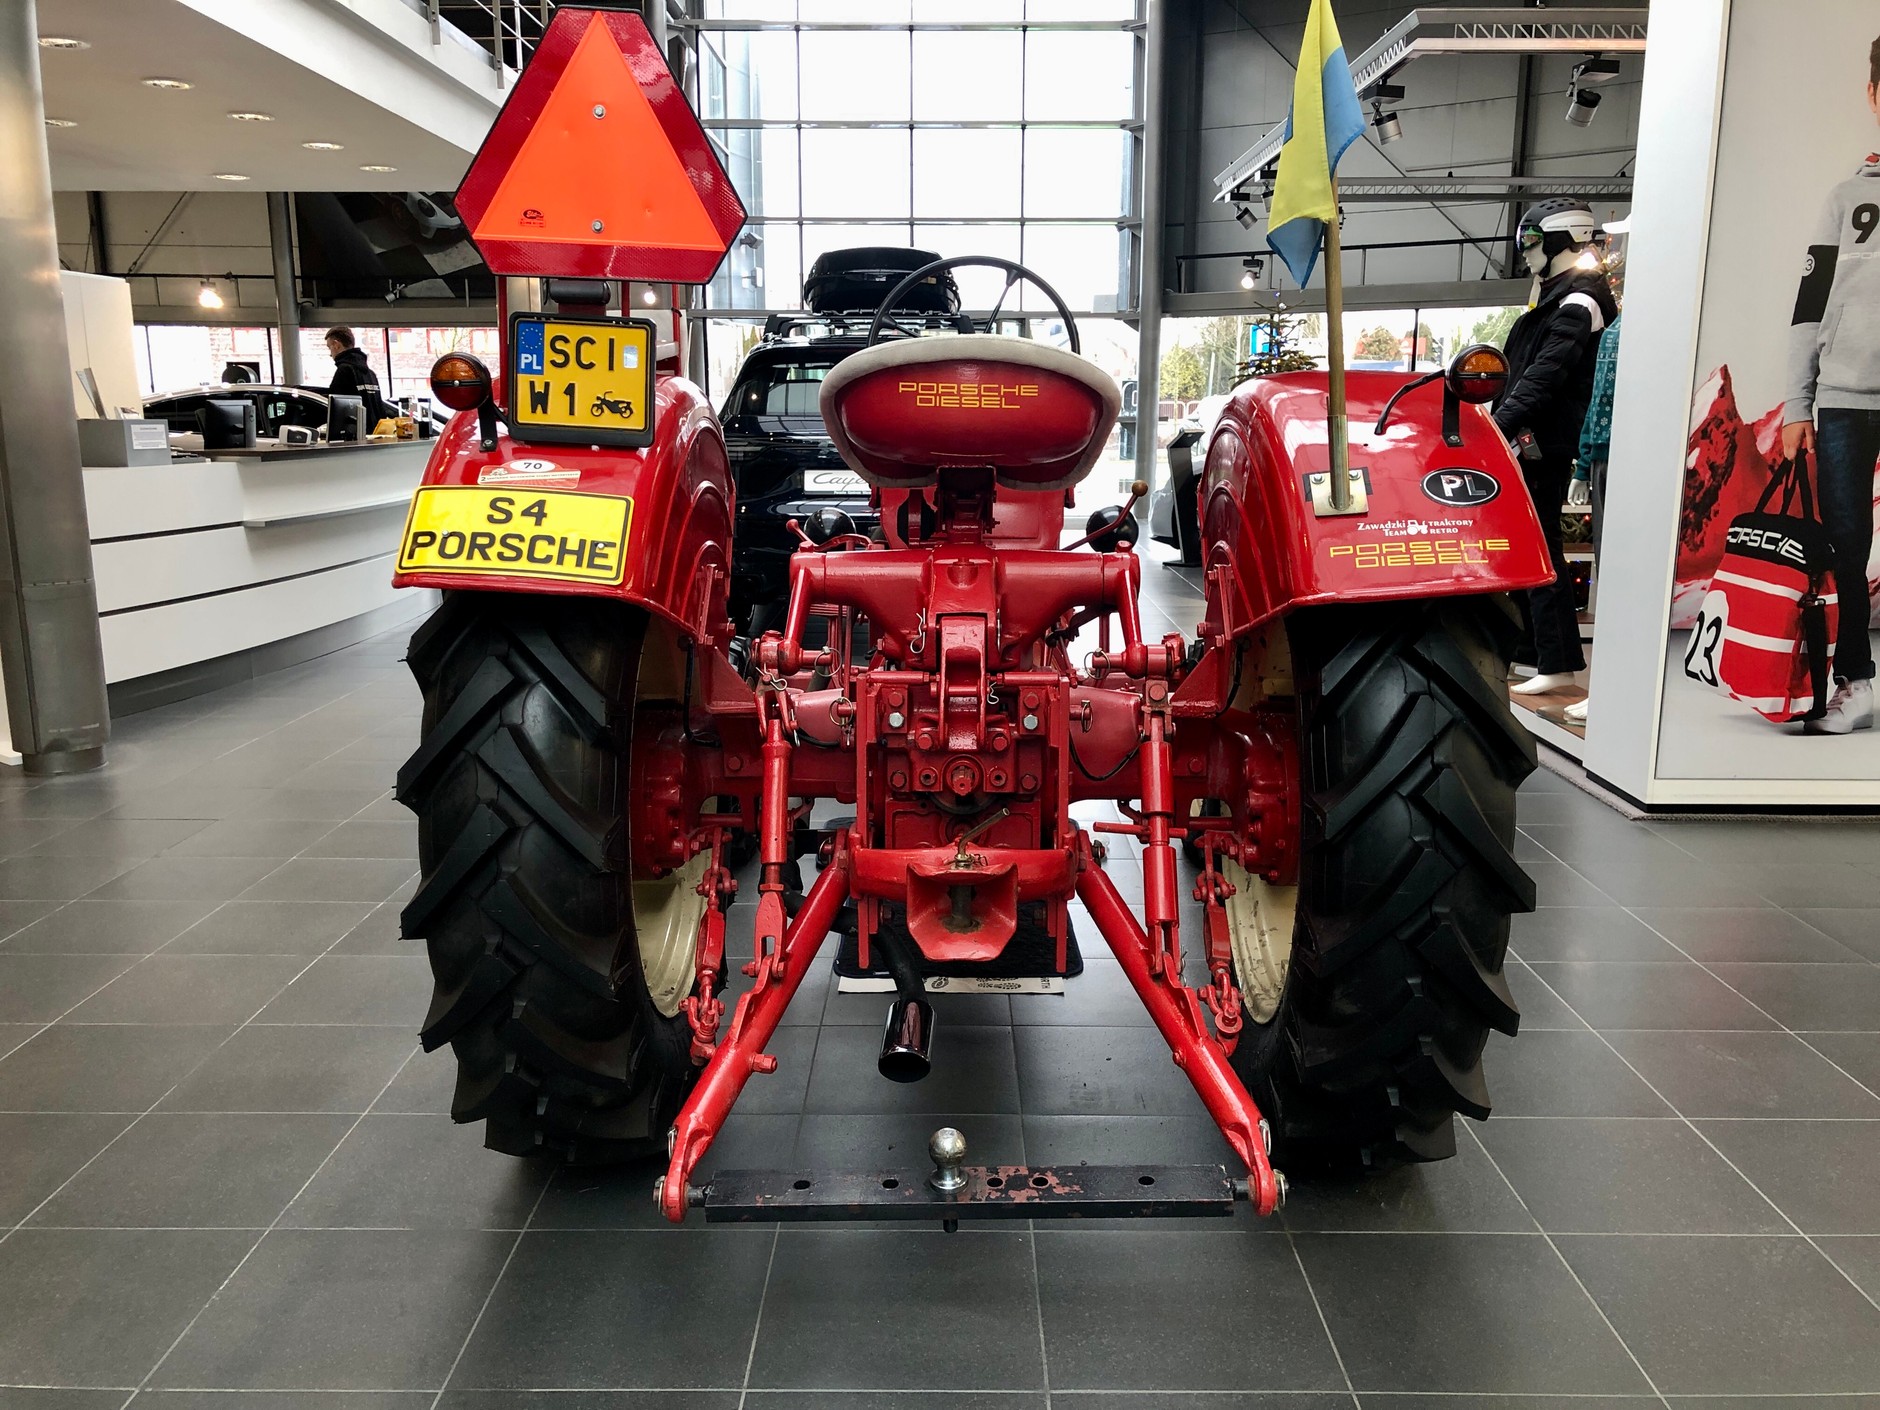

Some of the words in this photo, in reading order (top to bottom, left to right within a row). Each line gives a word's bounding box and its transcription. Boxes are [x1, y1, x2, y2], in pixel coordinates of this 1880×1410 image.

[1804, 258, 1814, 272] 3
[520, 353, 542, 371] PL
[898, 381, 1039, 397] PORSCHE
[916, 395, 1021, 409] DIESEL
[523, 462, 543, 470] 70
[813, 472, 867, 492] Caye
[1440, 474, 1487, 497] PL
[406, 530, 617, 571] PORSCHE
[1330, 538, 1511, 558] PORSCHE
[1355, 552, 1489, 569] DIESEL
[1684, 610, 1723, 687] 23
